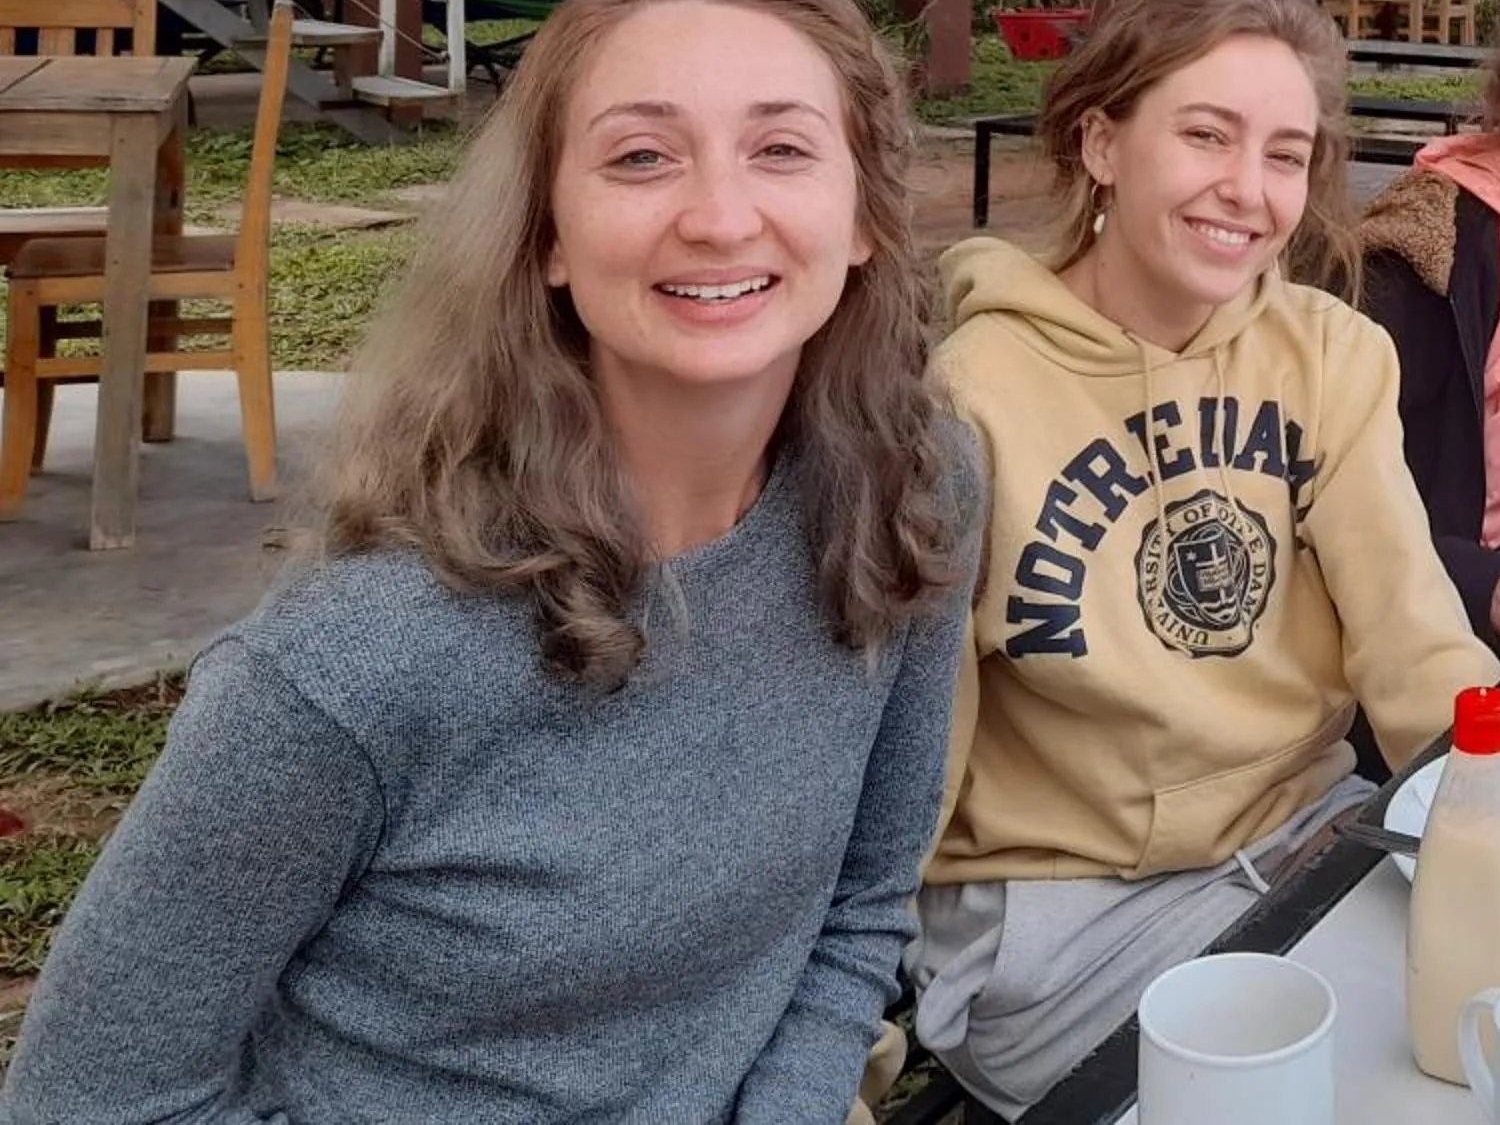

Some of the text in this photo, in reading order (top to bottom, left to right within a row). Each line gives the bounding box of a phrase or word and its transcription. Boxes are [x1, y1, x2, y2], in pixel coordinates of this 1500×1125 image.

[1005, 395, 1316, 659] NOTRE DA
[1183, 501, 1213, 524] OF
